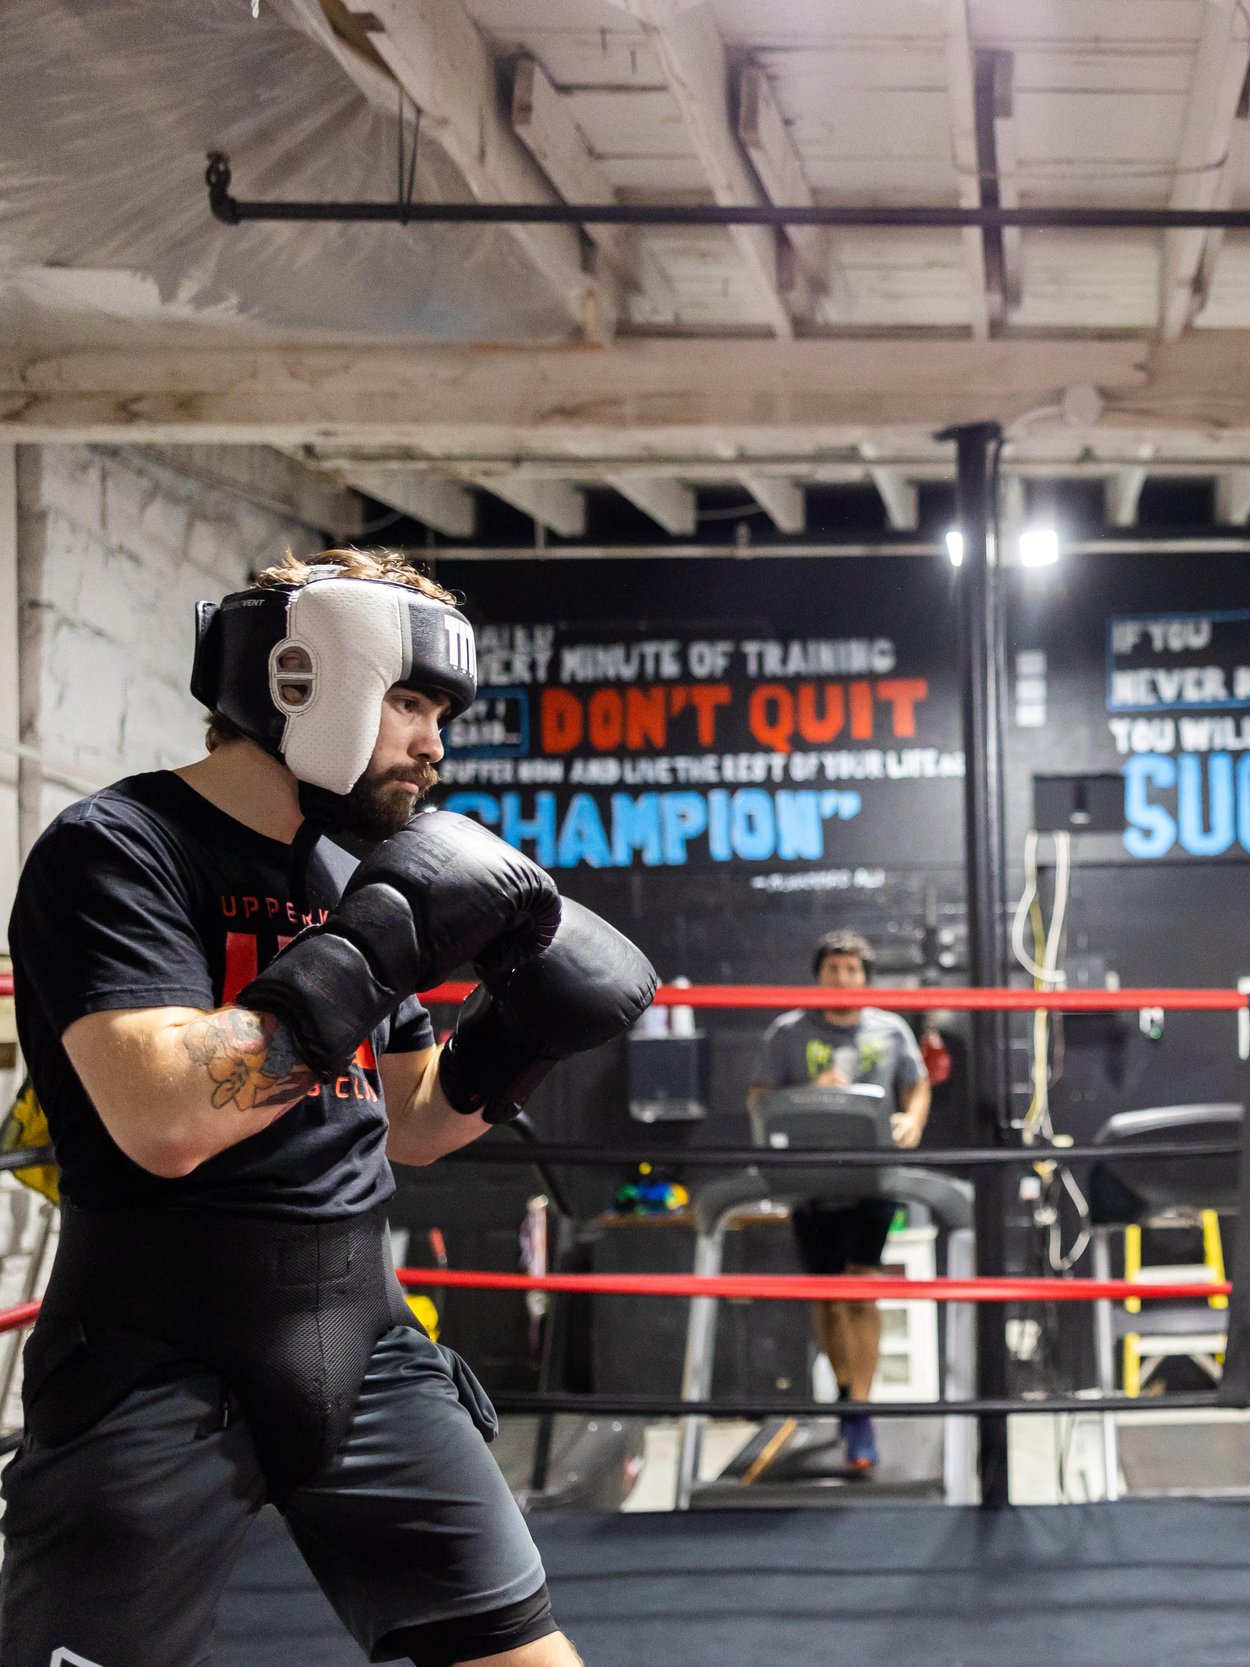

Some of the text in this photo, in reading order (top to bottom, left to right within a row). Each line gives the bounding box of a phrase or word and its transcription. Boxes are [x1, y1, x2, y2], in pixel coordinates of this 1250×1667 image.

[688, 640, 734, 679] OF
[541, 678, 928, 754] DON'T QUIT
[1109, 719, 1175, 754] YOU
